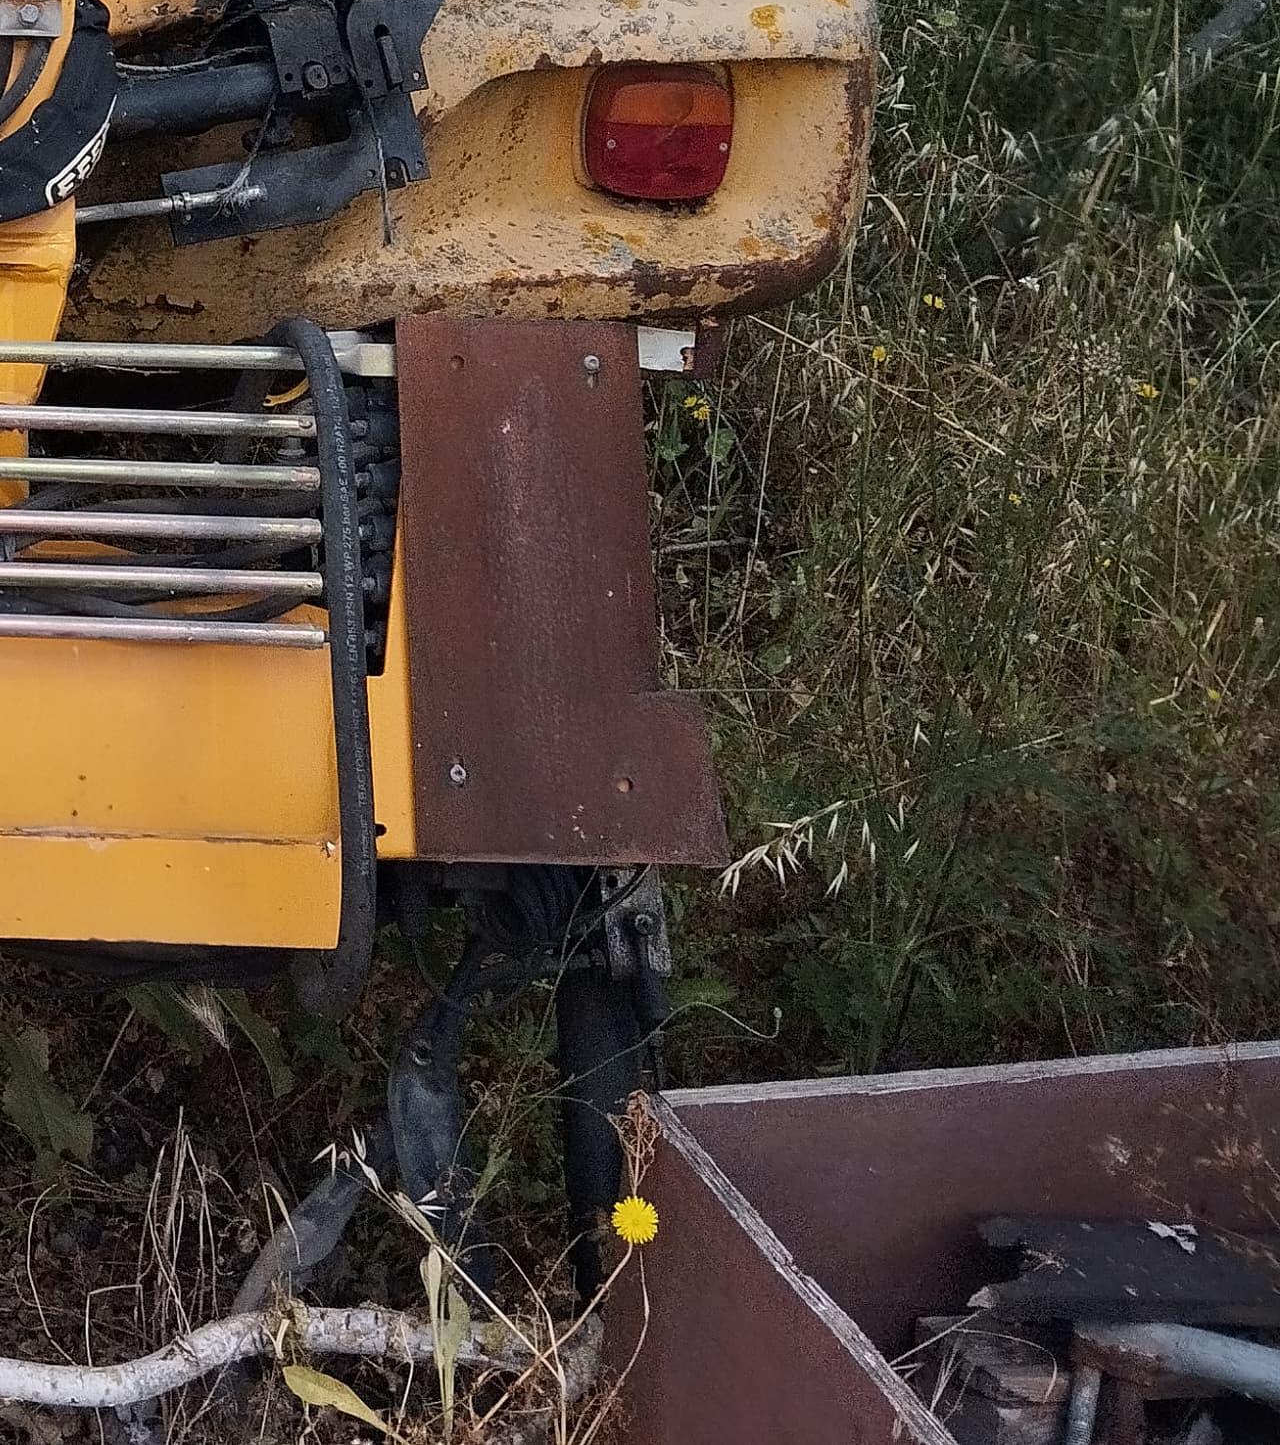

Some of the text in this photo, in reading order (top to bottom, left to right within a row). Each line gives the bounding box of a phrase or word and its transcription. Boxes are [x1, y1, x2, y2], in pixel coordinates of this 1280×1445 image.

[337, 456, 347, 473] 100
[341, 503, 351, 526] bar
[342, 527, 352, 549] 275
[343, 551, 353, 571] WP
